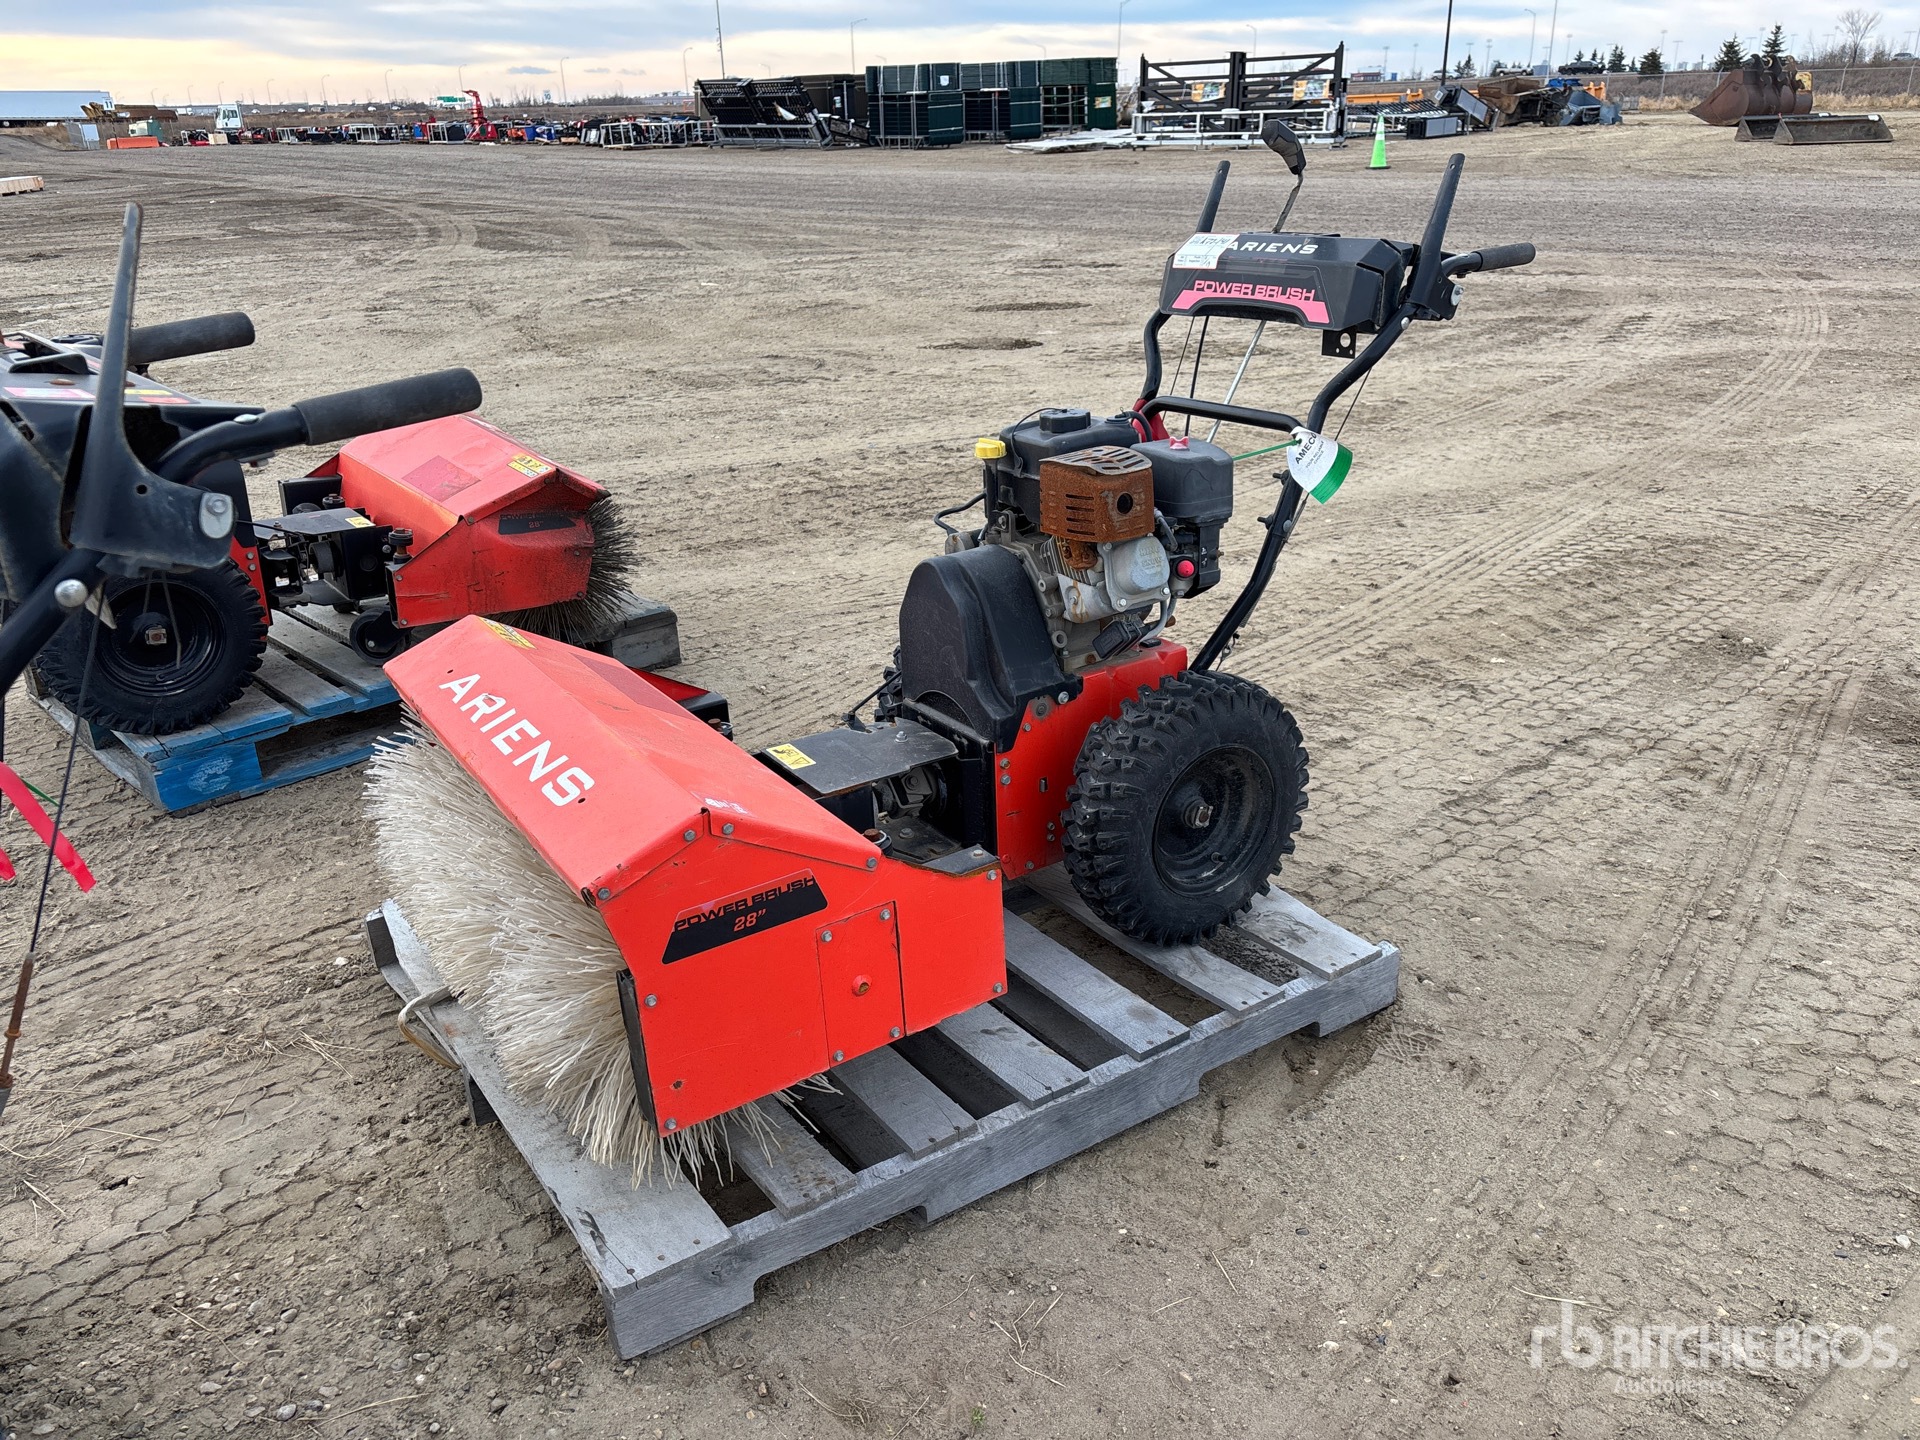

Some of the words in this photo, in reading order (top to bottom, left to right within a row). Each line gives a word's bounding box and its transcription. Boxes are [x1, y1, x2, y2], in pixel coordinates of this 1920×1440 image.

[1227, 241, 1319, 255] ARIENS
[1194, 280, 1252, 297] POWER
[1254, 284, 1315, 302] BRUSH
[438, 673, 595, 806] ARIENS
[673, 898, 750, 932] POWER
[751, 875, 817, 906] BRUSH
